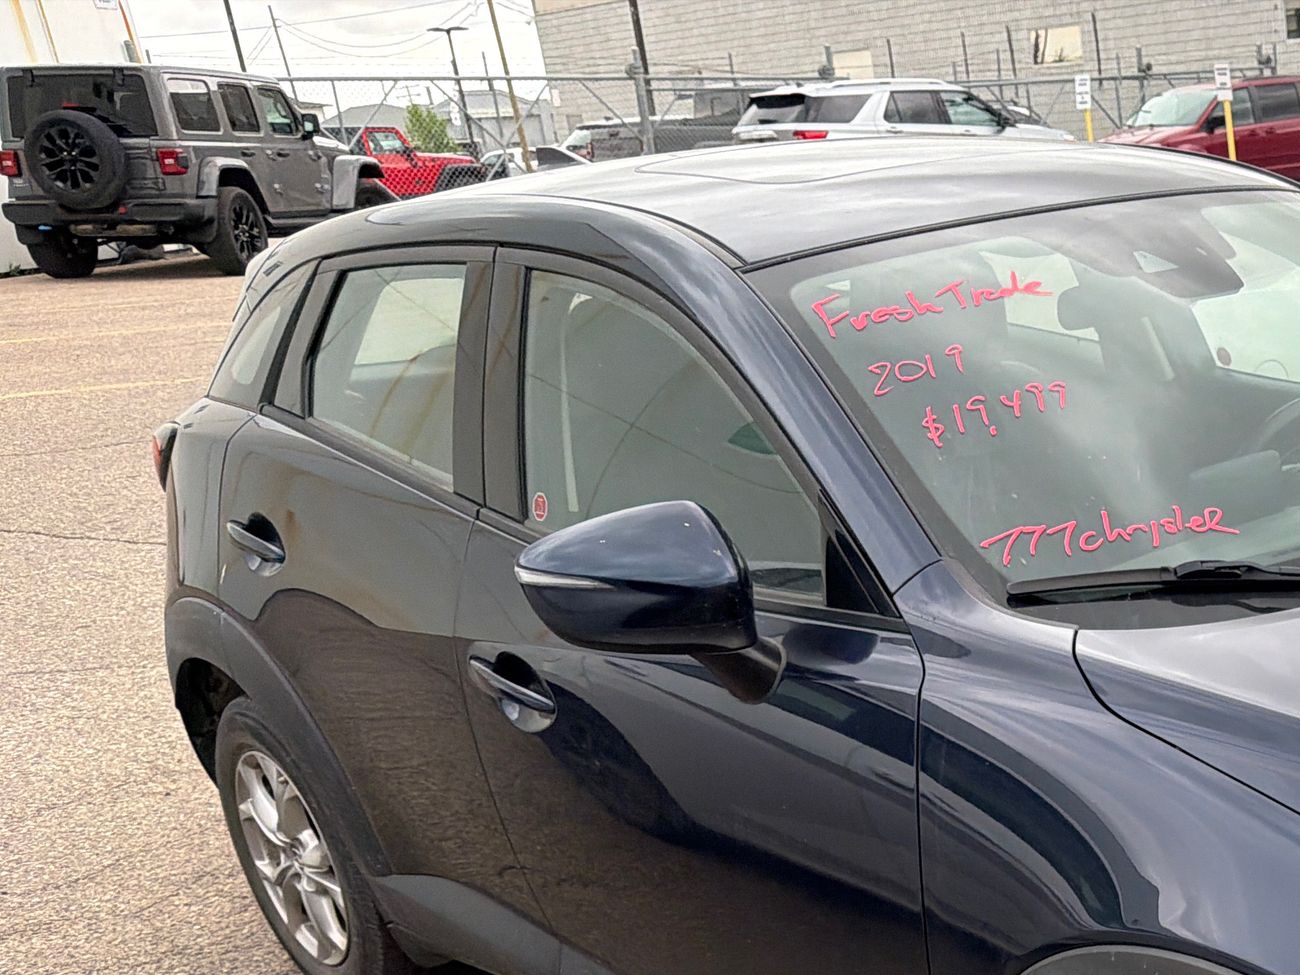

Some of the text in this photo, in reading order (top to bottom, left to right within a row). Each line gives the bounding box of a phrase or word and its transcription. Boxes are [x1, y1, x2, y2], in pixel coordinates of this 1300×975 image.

[811, 270, 1054, 338] Fresh Trade
[867, 344, 965, 397] 2019
